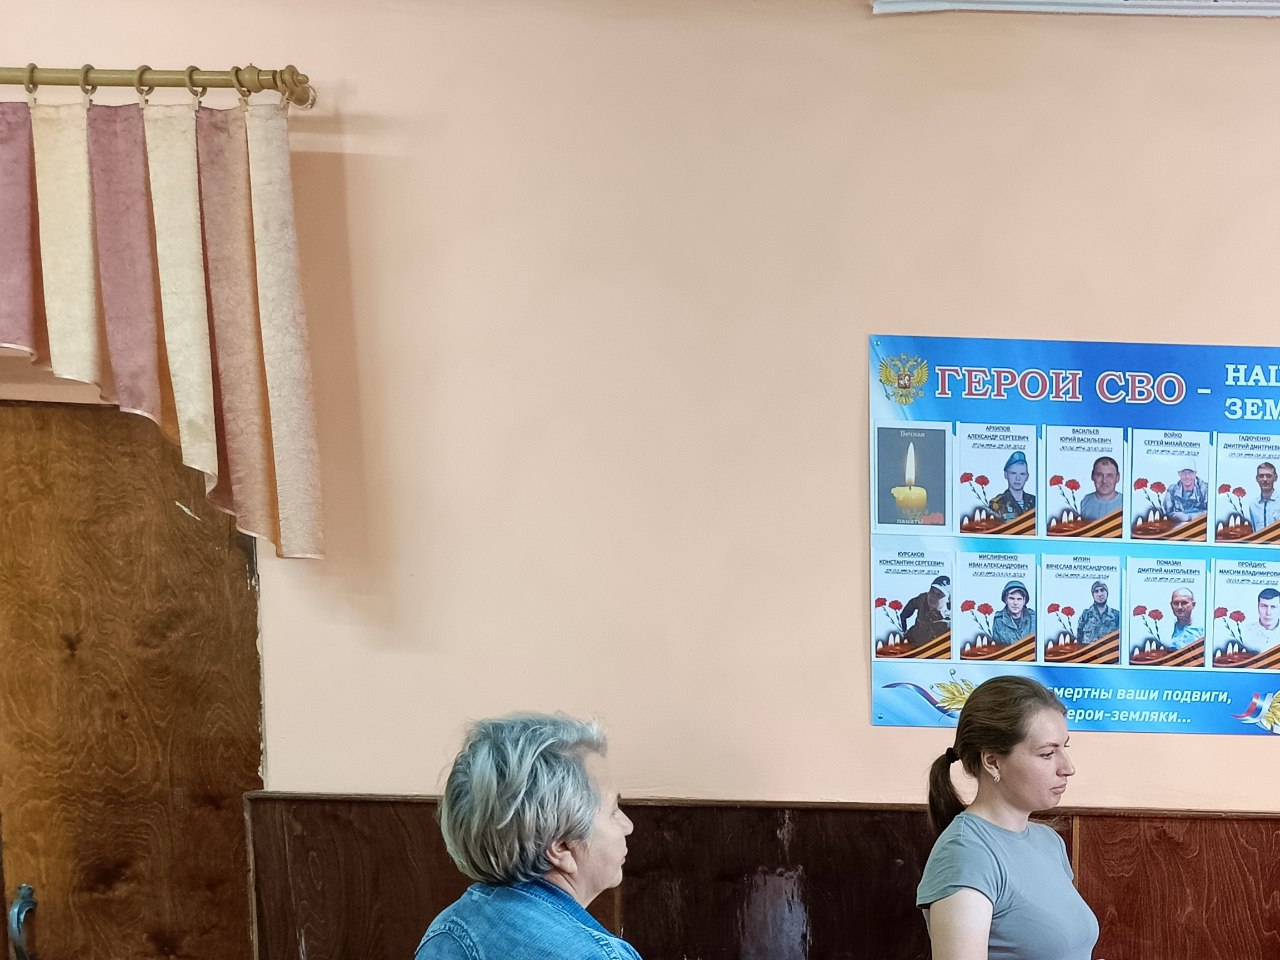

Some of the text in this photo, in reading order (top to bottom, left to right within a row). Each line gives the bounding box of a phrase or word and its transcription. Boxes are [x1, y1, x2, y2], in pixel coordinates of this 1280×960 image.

[935, 365, 1082, 402] ГЕРОИ
[1095, 369, 1186, 406] СВО
[1047, 687, 1232, 705] мертны ваши подвиги,
[1066, 708, 1191, 723] ерои-земляки...
